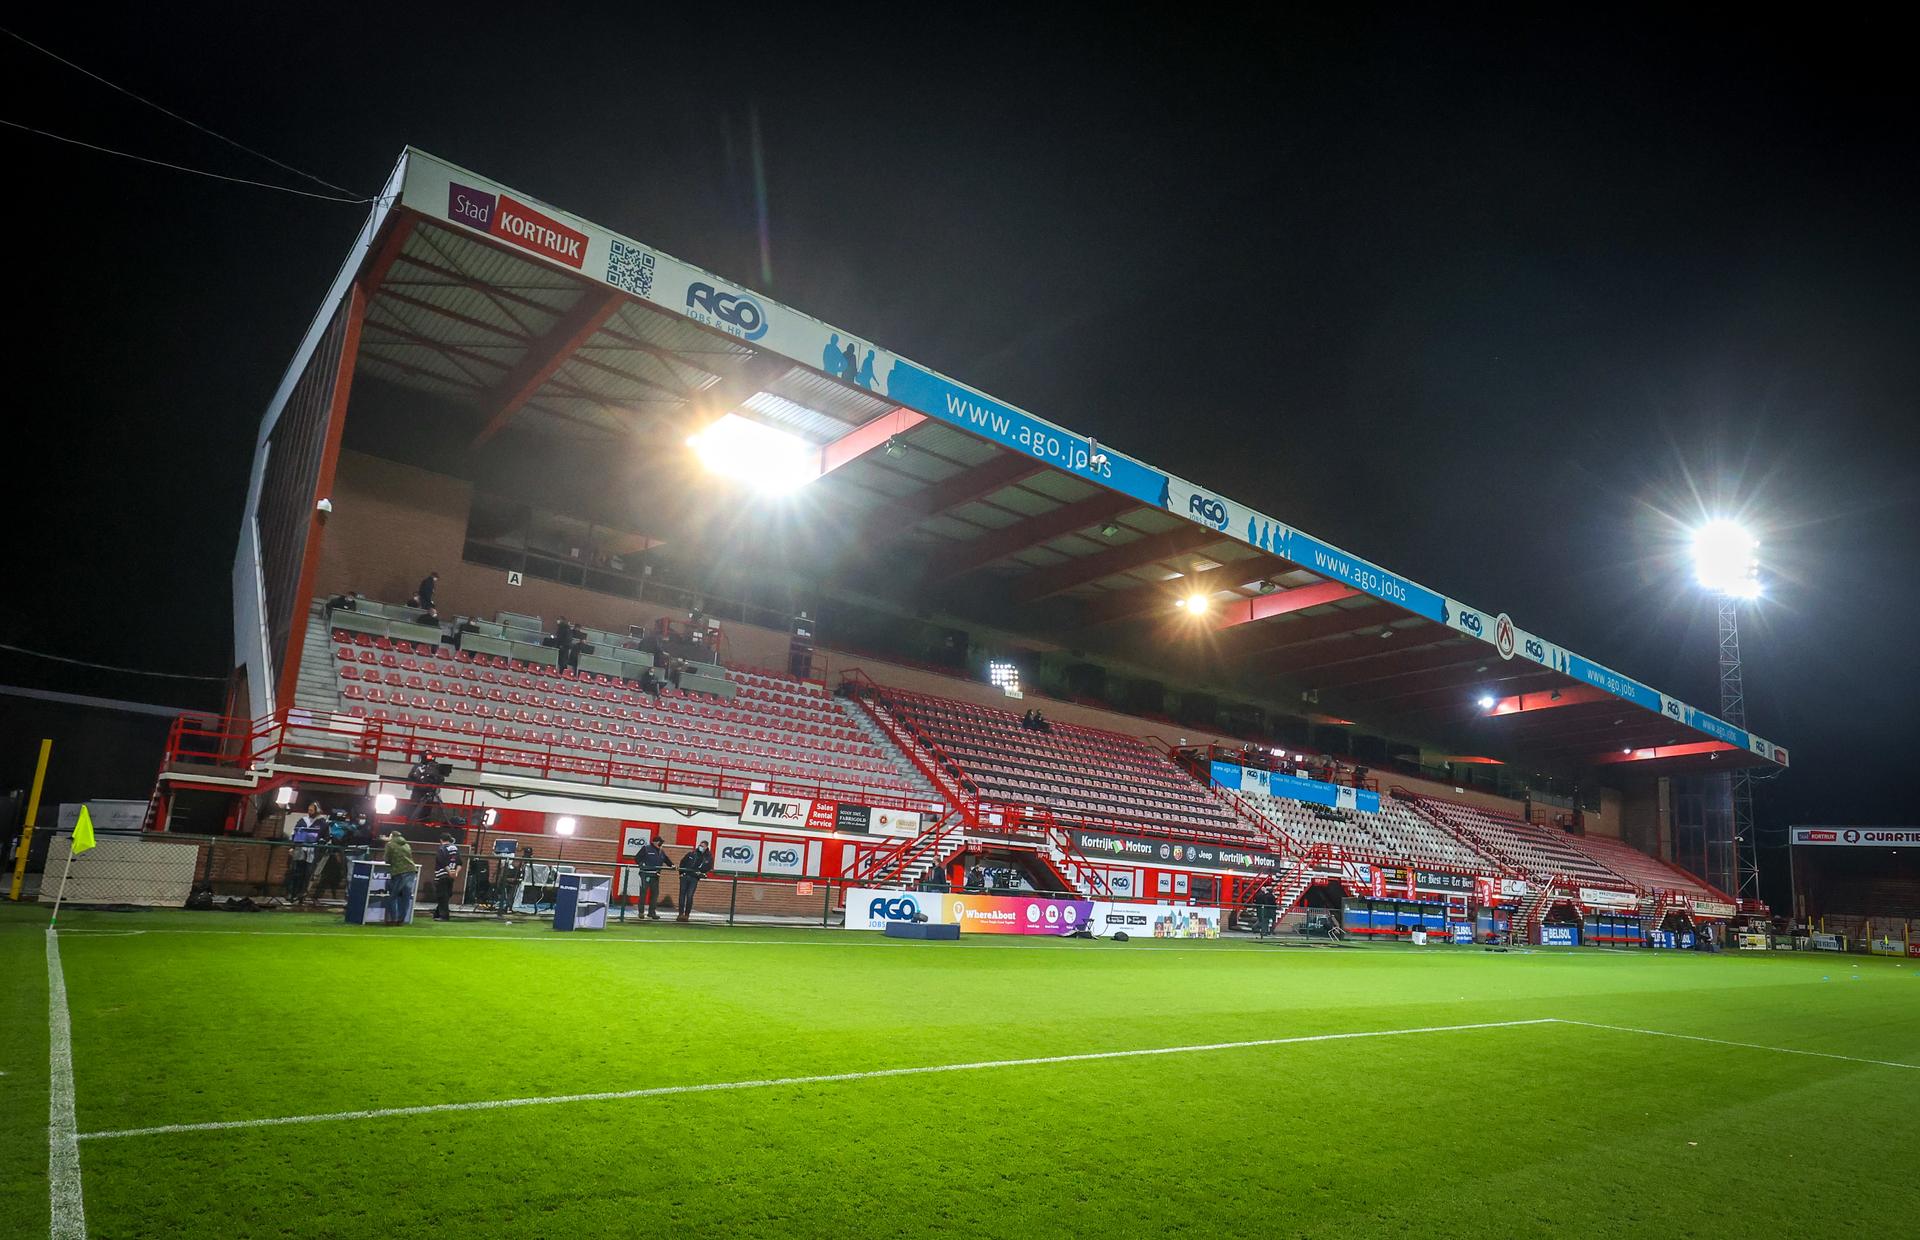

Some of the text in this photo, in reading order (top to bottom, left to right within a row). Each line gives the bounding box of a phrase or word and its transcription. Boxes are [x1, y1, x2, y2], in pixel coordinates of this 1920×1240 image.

[455, 193, 489, 224] Stad
[500, 210, 581, 260] KORTRIJK
[686, 281, 760, 331] AGO
[1189, 494, 1225, 524] AGO
[510, 573, 520, 585] A
[1315, 549, 1406, 602] www.ago.jobs
[1460, 611, 1480, 632] AGO
[1525, 639, 1543, 659] AGO
[1586, 668, 1636, 698] www.ago.jobs
[752, 800, 786, 818] TVH
[812, 811, 833, 819] Rental
[816, 803, 833, 811] Sales
[808, 819, 832, 828] Service
[721, 846, 751, 860] AGO
[1081, 835, 1152, 854] Kortrijk Motors
[768, 850, 796, 863] AGO
[1198, 850, 1213, 861] Jeep
[1219, 851, 1275, 867] Kortrijk Motors
[1111, 877, 1128, 888] AGO
[869, 897, 916, 920] AGO
[965, 909, 1016, 920] WhereAbout
[1548, 928, 1572, 940] BELISOL
